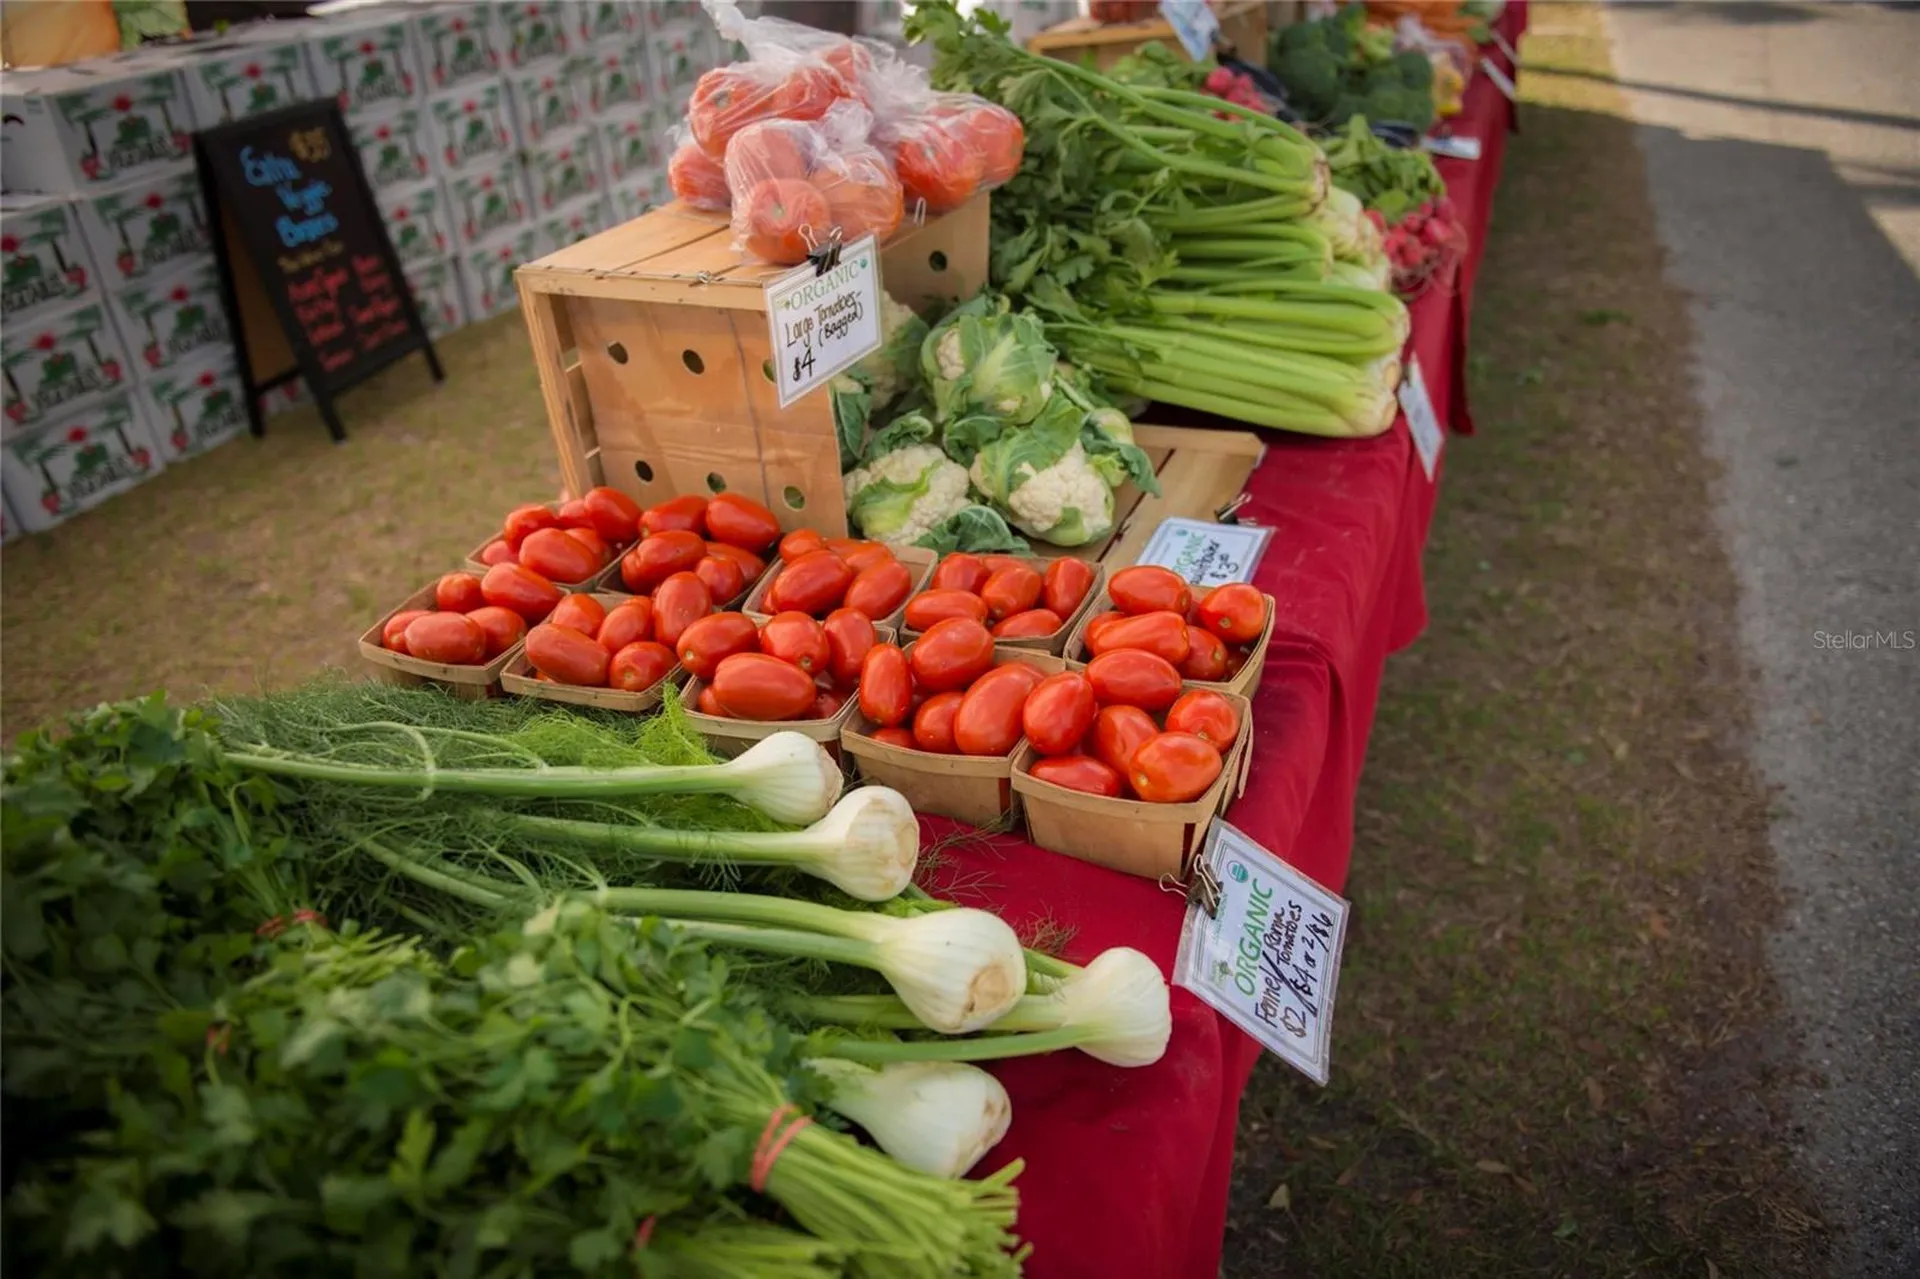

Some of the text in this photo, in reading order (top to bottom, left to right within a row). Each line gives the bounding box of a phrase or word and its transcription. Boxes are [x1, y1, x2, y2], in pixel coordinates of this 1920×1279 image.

[790, 260, 859, 311] ORGANIC
[785, 317, 814, 348] Large
[793, 347, 816, 381] $4
[1171, 532, 1207, 572] RGANIC
[1234, 878, 1273, 997] ORGANIC
[1263, 906, 1285, 953] Roma
[1280, 899, 1303, 966] Tomatoes
